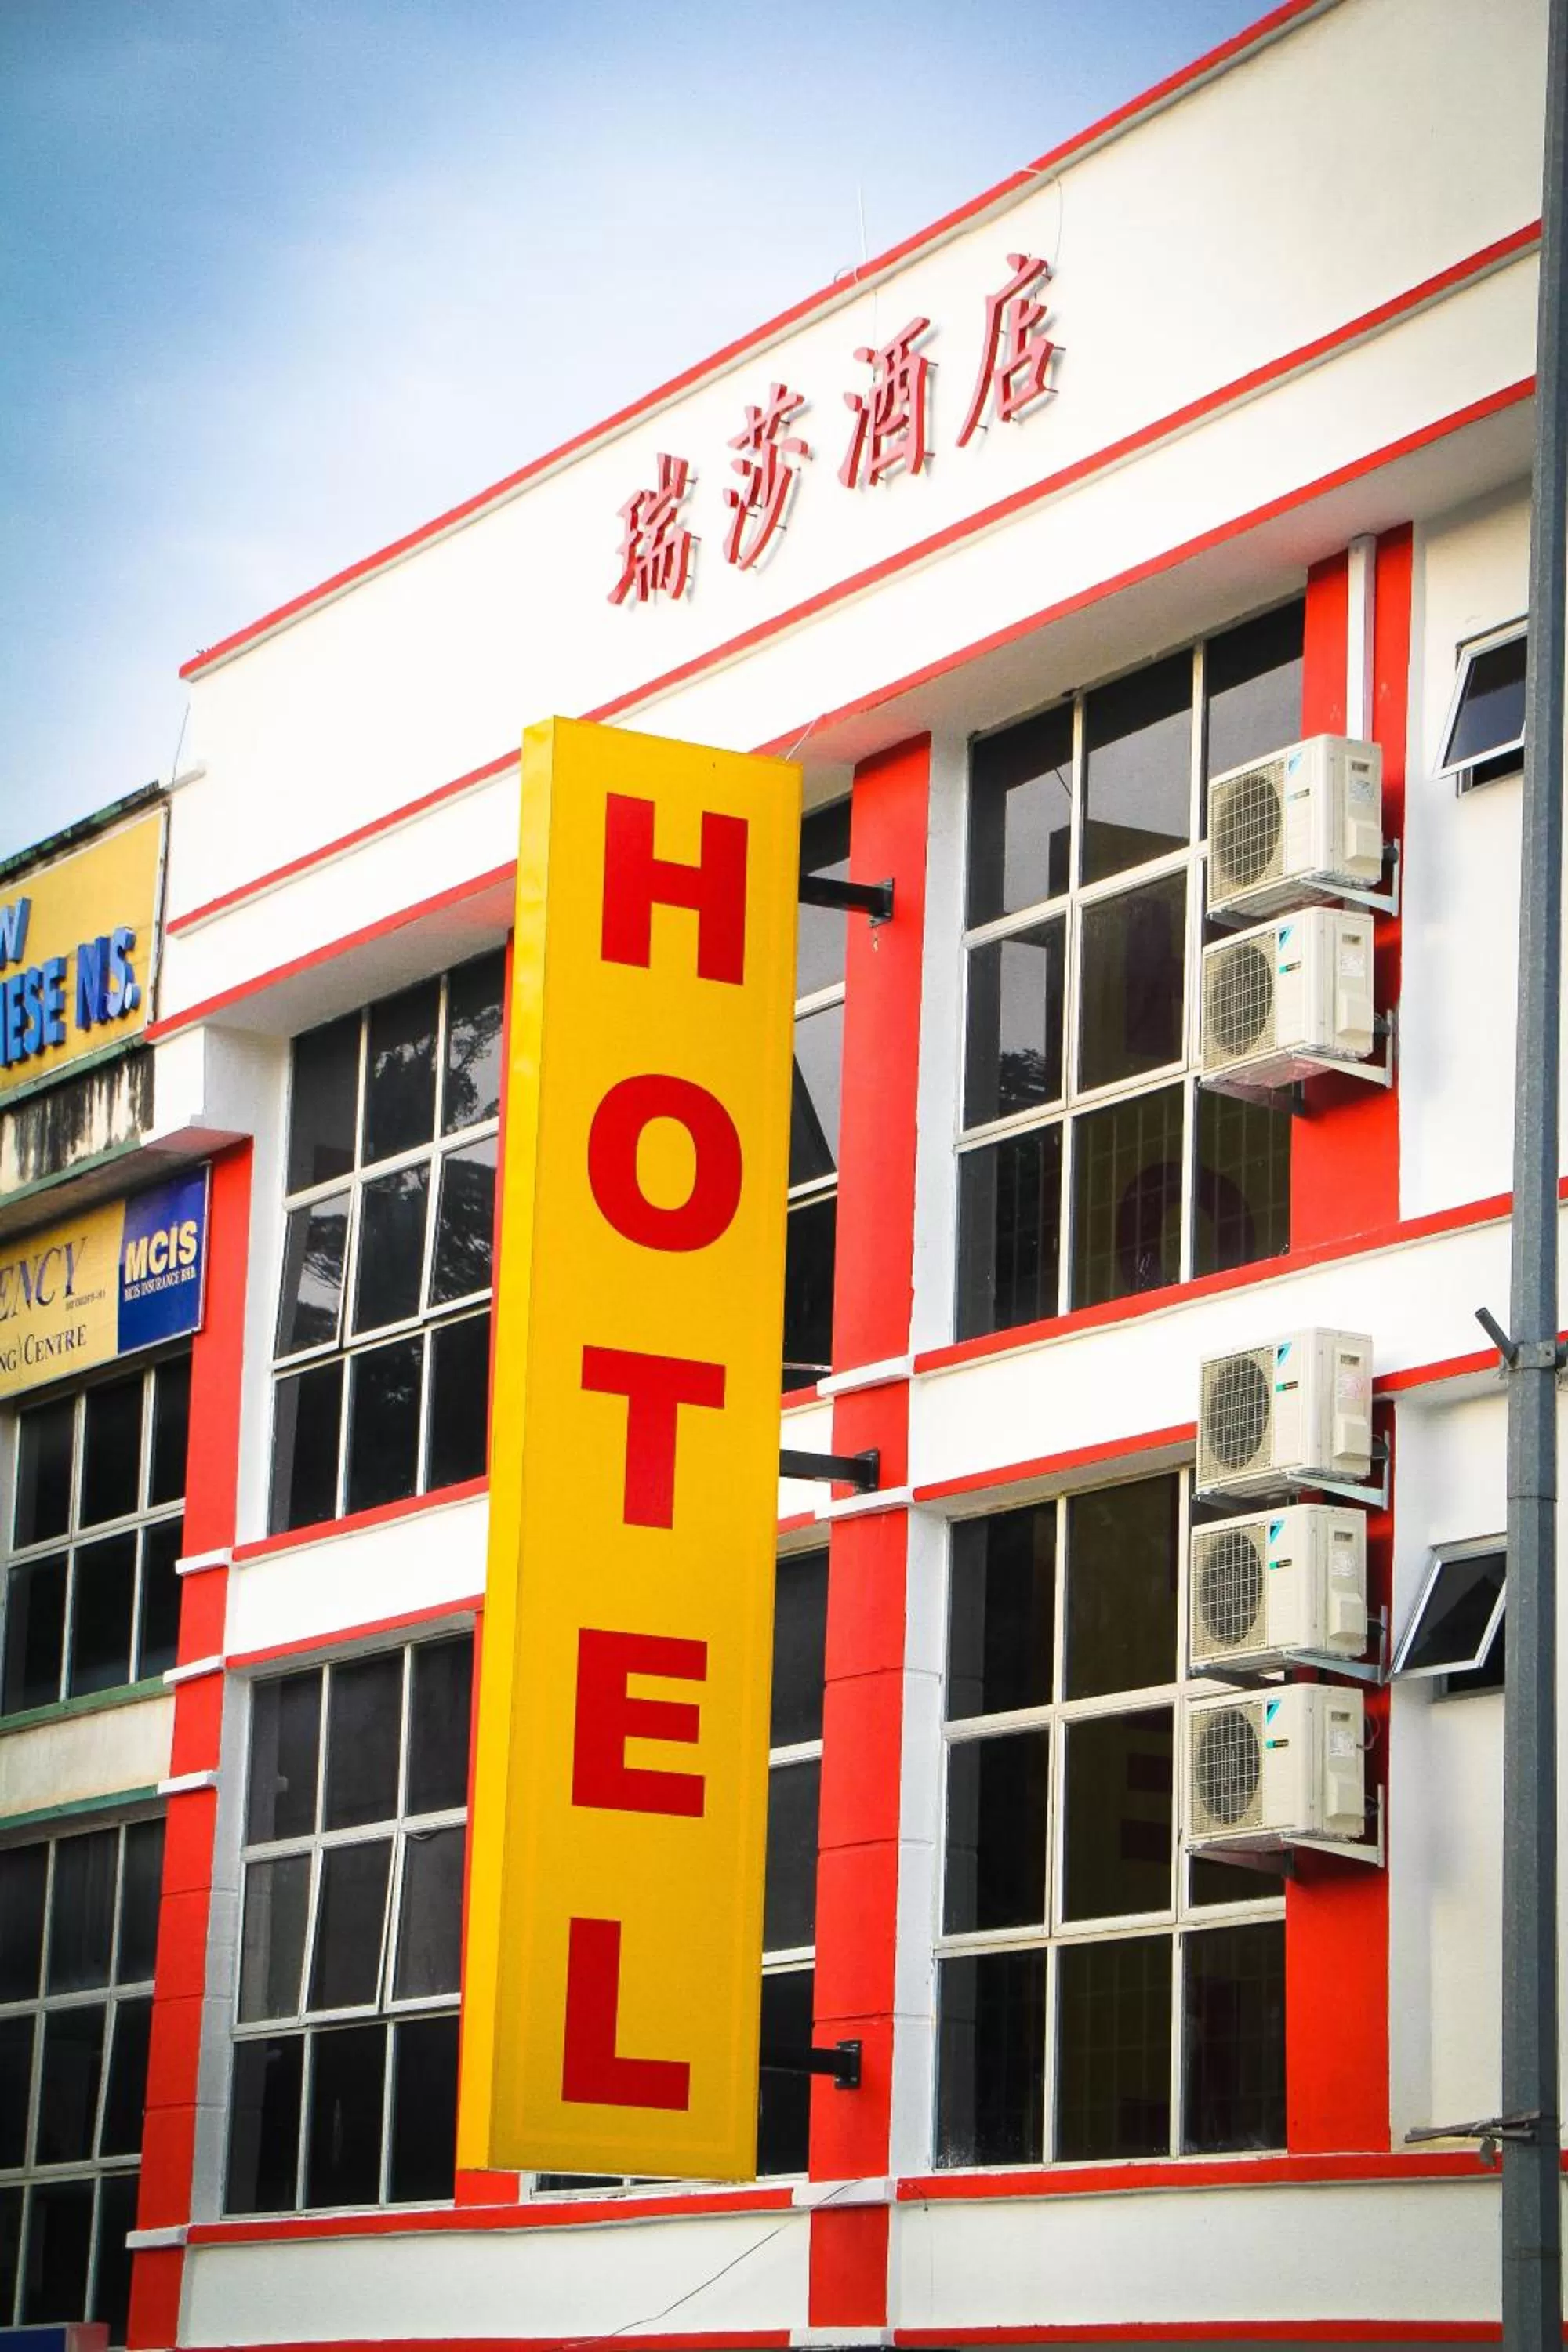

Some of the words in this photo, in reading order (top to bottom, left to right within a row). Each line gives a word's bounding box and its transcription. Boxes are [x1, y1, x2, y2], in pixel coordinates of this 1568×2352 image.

[607, 253, 1054, 604] 瑞莎酒店
[125, 1220, 197, 1284] MCIS
[561, 793, 748, 2111] HOTEL
